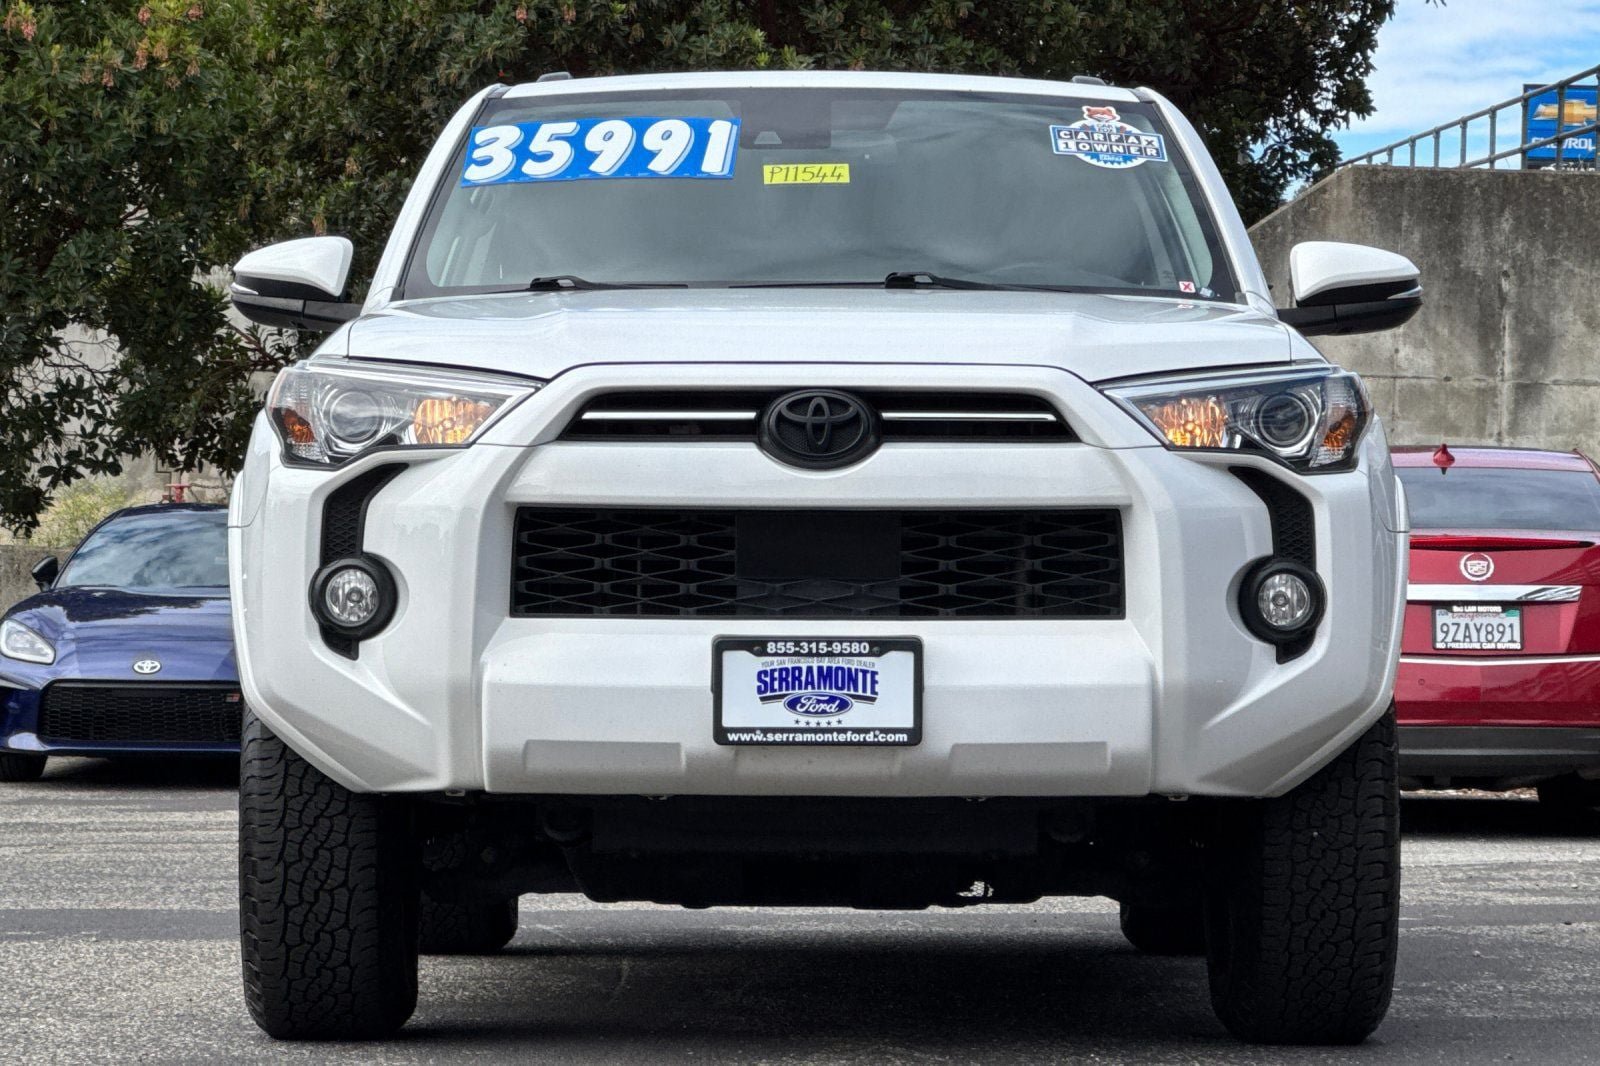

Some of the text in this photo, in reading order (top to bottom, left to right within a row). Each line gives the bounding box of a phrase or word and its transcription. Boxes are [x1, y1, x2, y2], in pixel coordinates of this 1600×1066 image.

[1059, 129, 1156, 147] CARFAX
[464, 119, 738, 183] 35991
[1062, 141, 1158, 157] 1 OWNER
[769, 165, 844, 183] P11544
[1440, 622, 1517, 643] 9ZAY891
[766, 642, 870, 654] 855-315-9580
[761, 660, 775, 668] YOUR
[776, 658, 787, 666] SAN
[787, 656, 815, 665] FRANCISCO
[816, 656, 826, 664] BAY
[841, 657, 855, 666] FORD
[856, 659, 876, 668] DEALER
[756, 665, 879, 696] SERRAMONTE
[796, 695, 839, 714] Ford
[727, 731, 908, 742] www.serramonteford.com
